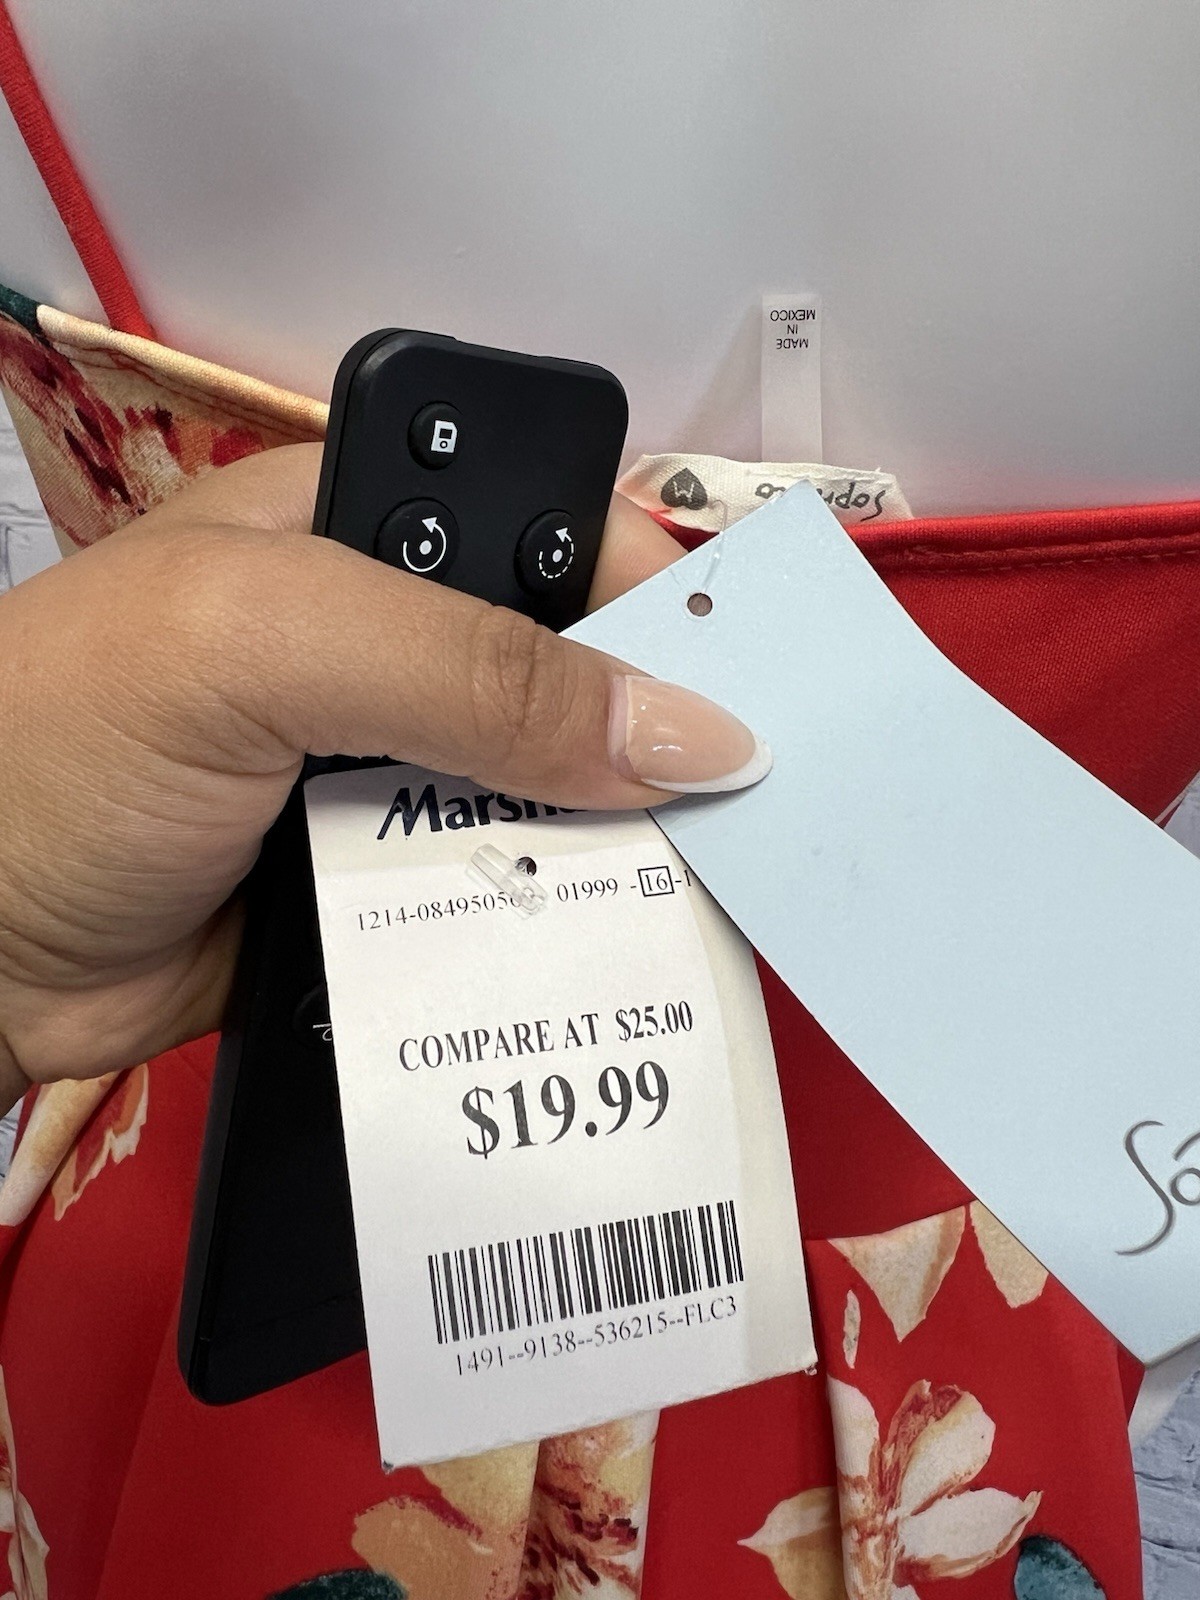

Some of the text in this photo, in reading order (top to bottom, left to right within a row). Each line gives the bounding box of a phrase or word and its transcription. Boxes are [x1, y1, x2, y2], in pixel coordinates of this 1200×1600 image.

[770, 309, 816, 322] MEXICO
[787, 324, 798, 335] IN
[776, 338, 809, 350] MADE
[556, 877, 619, 902] 01999
[399, 1000, 693, 1071] COMPARE AT $25.00
[461, 1060, 669, 1160] $19.99
